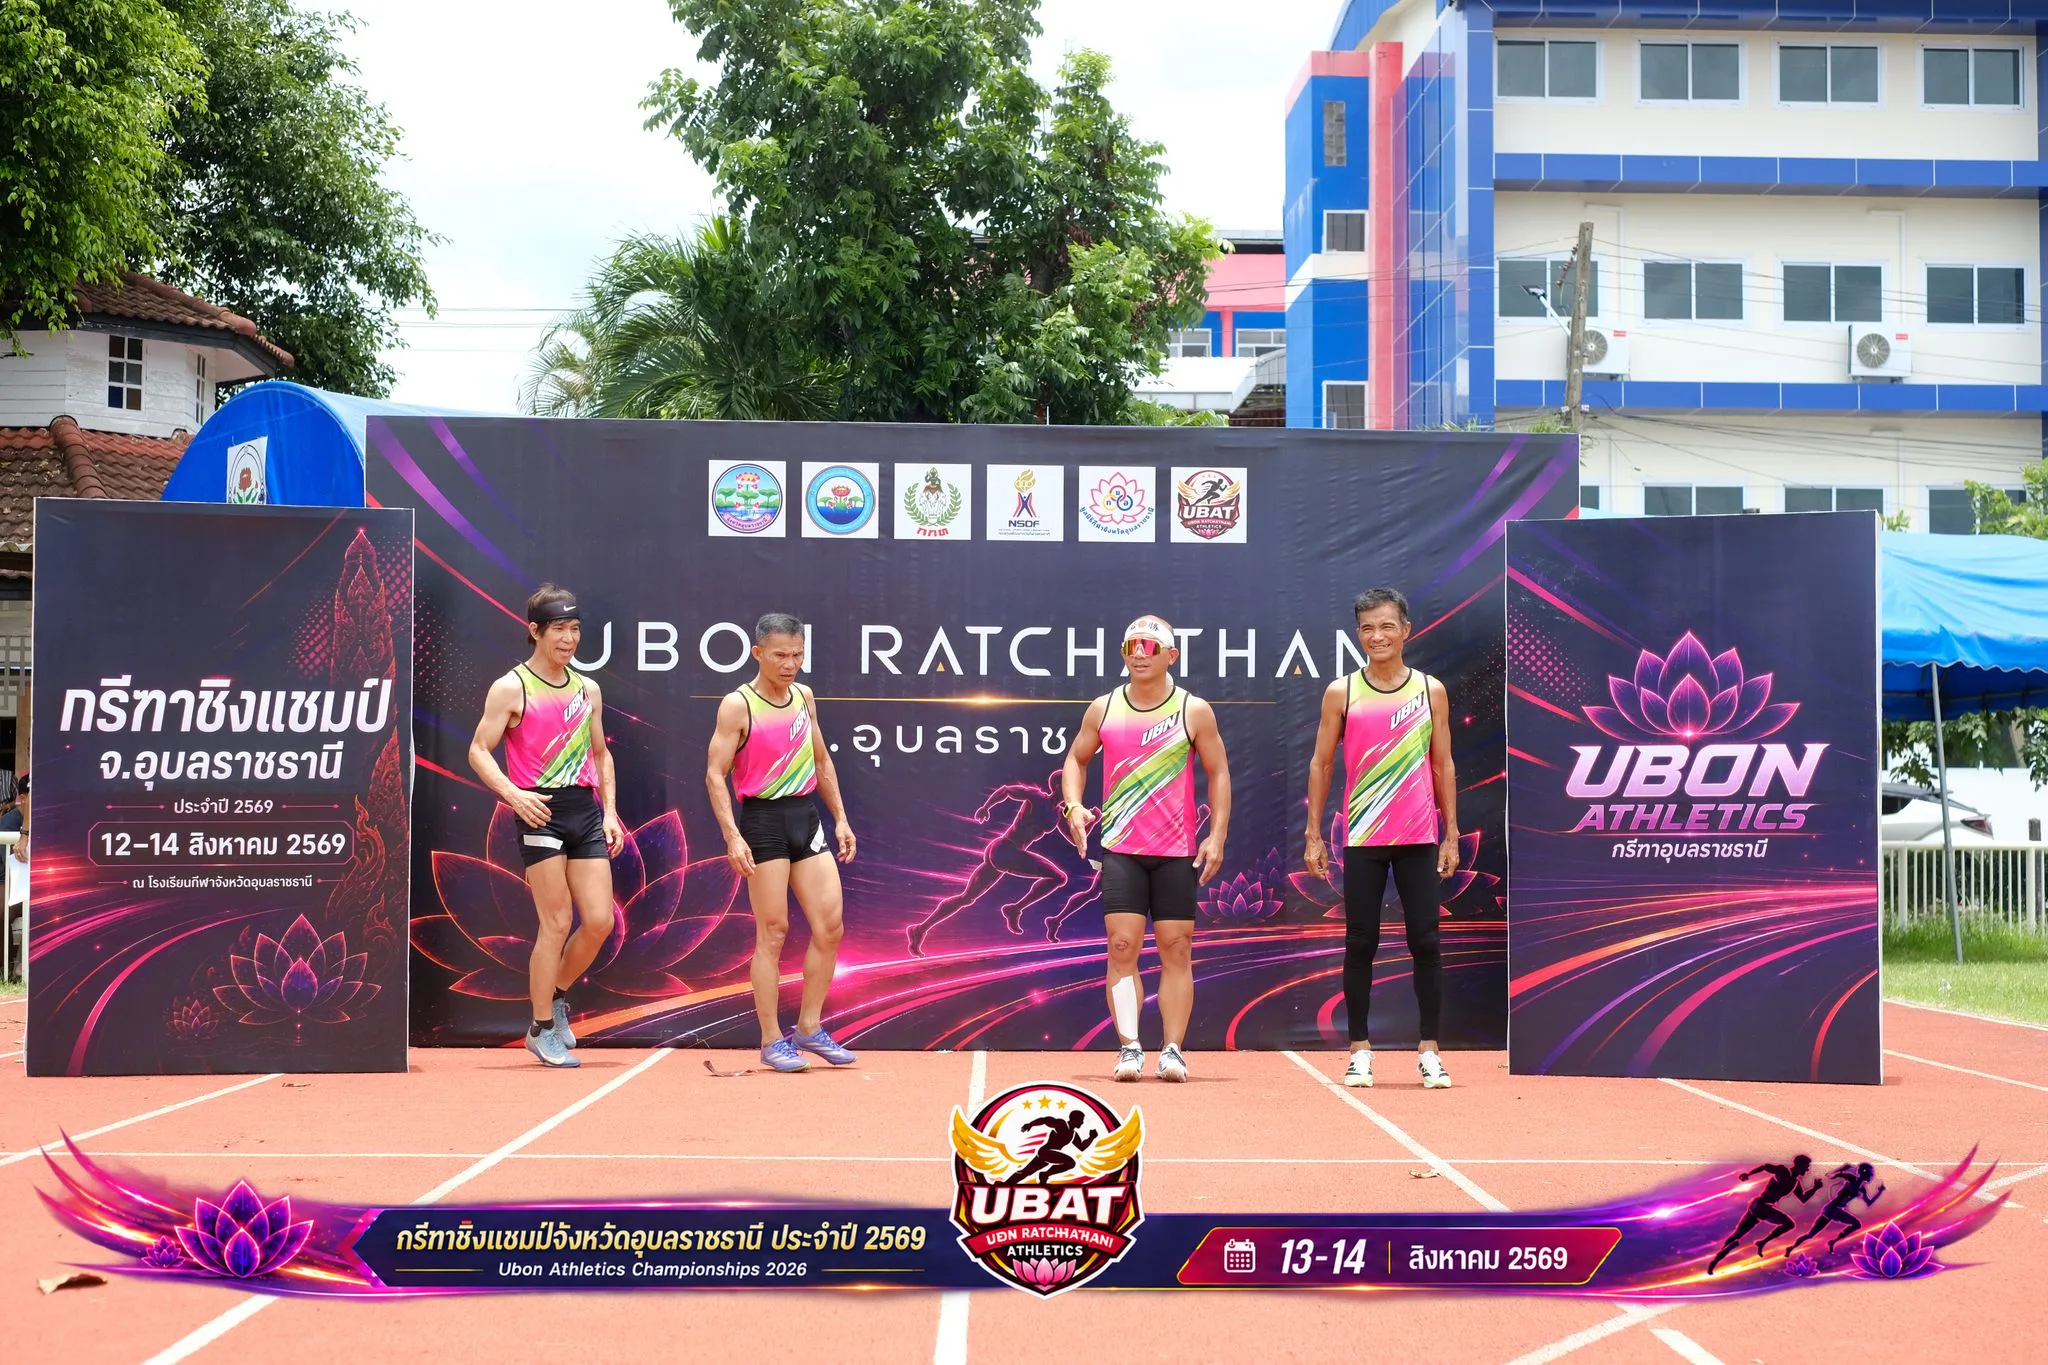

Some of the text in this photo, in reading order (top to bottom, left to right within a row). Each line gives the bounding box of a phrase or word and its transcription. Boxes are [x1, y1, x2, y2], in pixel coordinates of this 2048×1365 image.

[1008, 519, 1040, 528] NSDF
[1183, 506, 1236, 519] UBAT
[60, 674, 393, 733] กรีฑาชิงแชมป์
[1389, 691, 1425, 731] UBN
[1140, 710, 1181, 747] UBN
[99, 740, 345, 791] จ.อุบลราชธานี
[1565, 743, 1831, 798] UBON
[174, 797, 274, 814] ประจำปี 2569
[1567, 803, 1820, 834] ATHLETICS
[101, 832, 346, 856] 12-14 สิงหาคม 2569
[1611, 838, 1769, 864] กรีฑาอุบลราชธานี
[132, 874, 313, 890] ณ โรงเรียนกีฬาจังหวัดอุบลราชธานี
